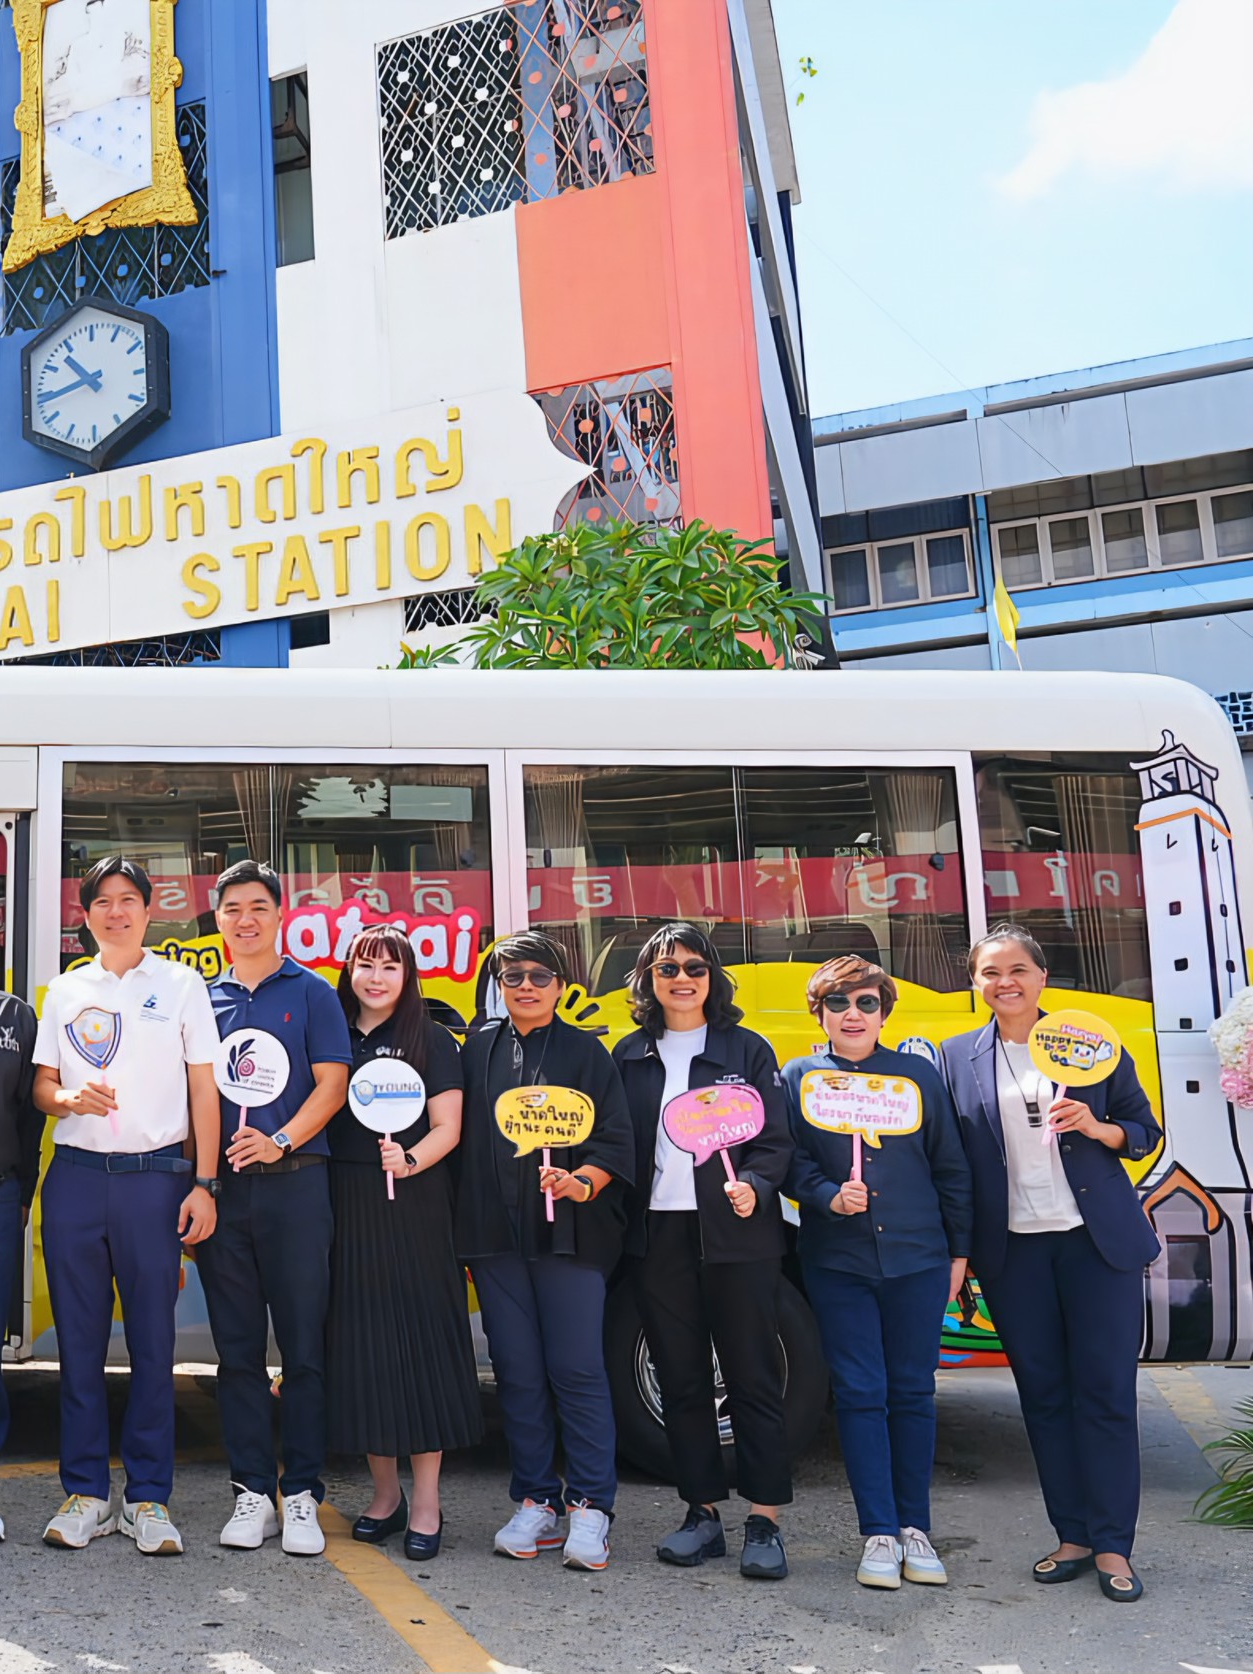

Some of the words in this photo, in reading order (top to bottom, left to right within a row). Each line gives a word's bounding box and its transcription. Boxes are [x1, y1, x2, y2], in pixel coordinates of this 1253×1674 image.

[182, 498, 512, 619] STATION
[275, 906, 474, 975] atai
[1035, 1032, 1072, 1046] Happy
[519, 1105, 584, 1126] หาดใหญ่
